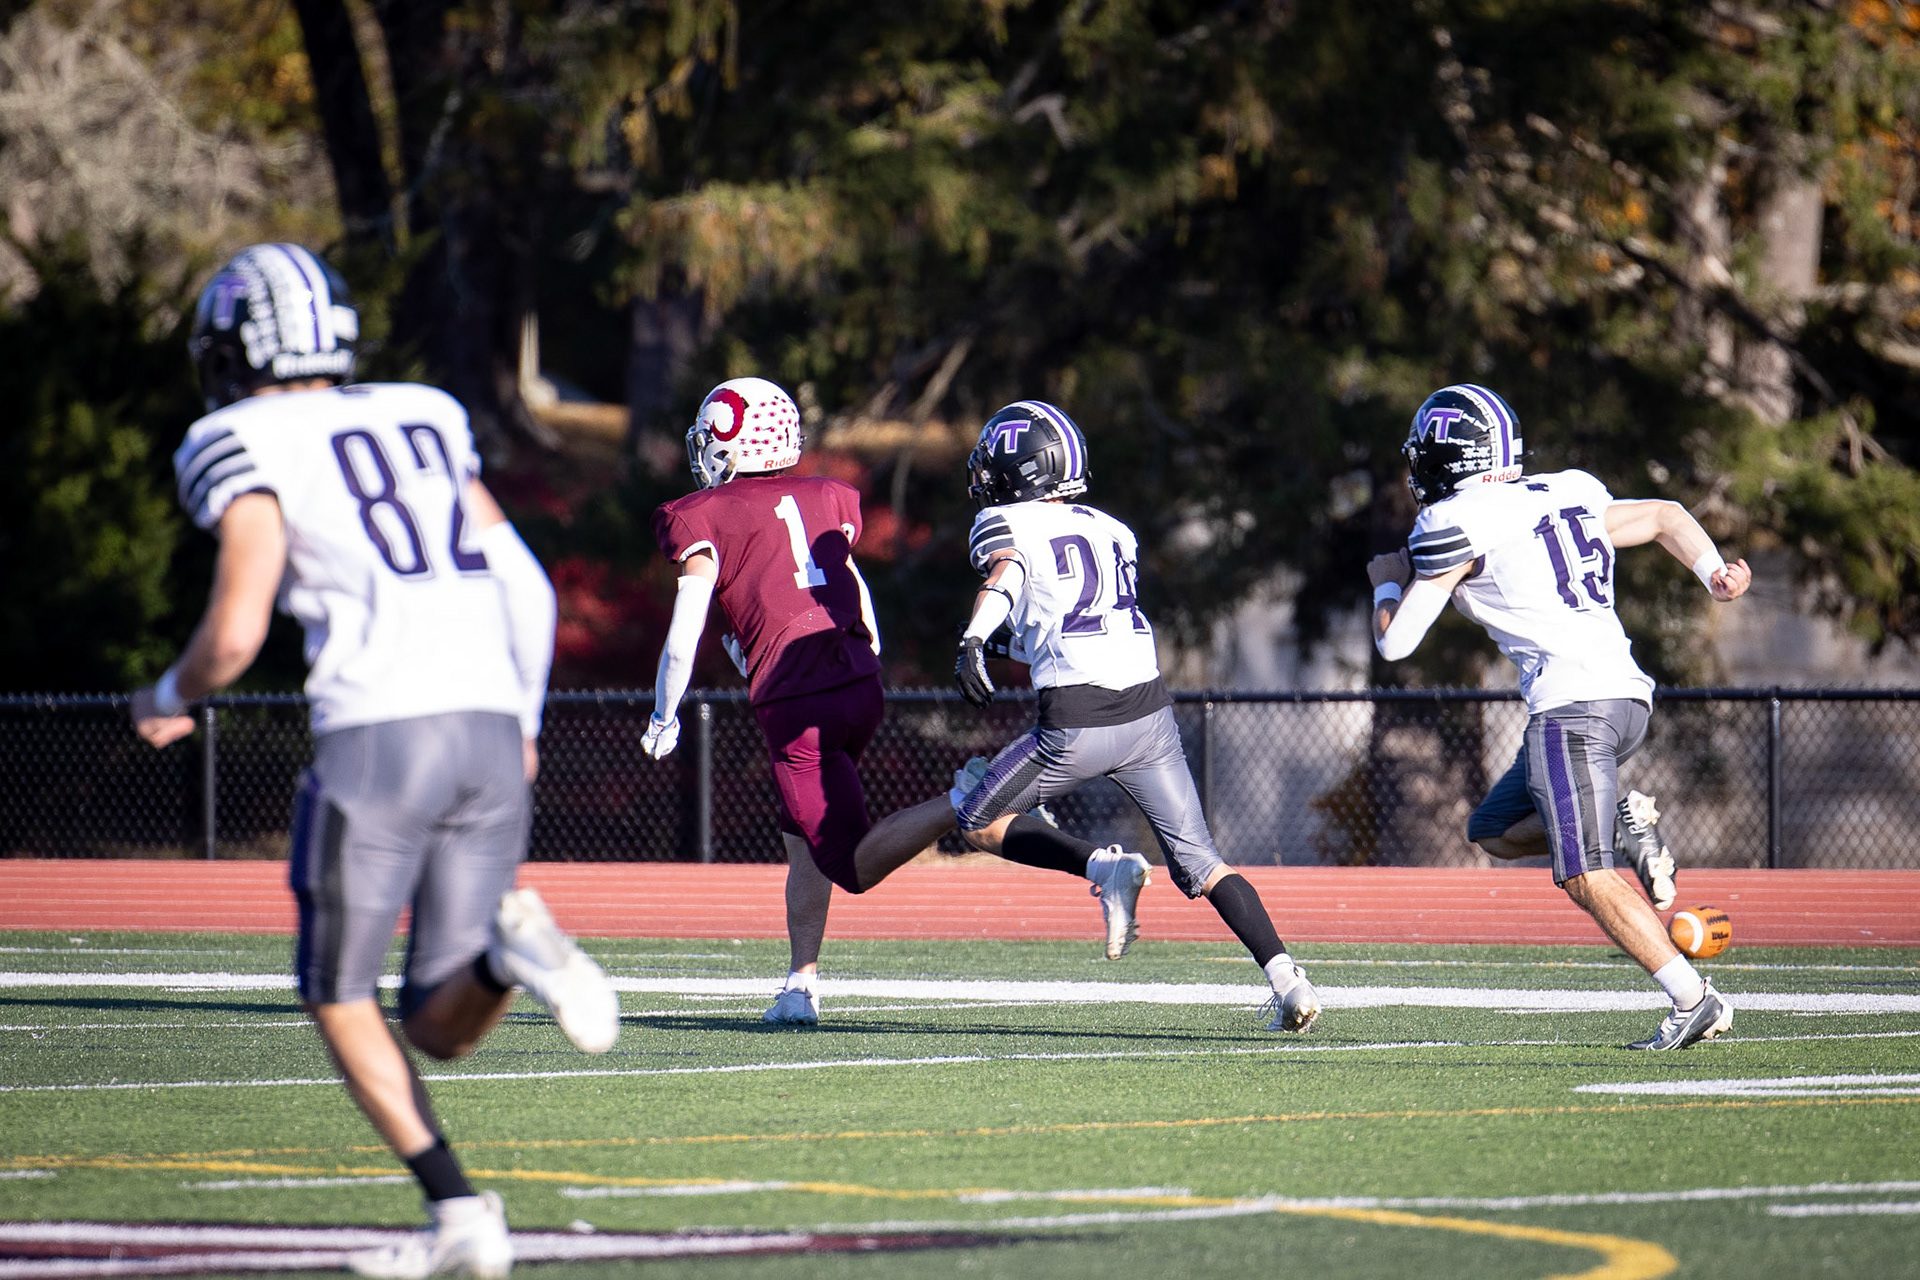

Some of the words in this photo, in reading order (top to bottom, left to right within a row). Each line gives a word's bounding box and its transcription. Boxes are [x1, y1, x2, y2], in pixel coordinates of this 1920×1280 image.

[330, 424, 490, 579] 82
[774, 494, 827, 589] 1
[1049, 534, 1150, 637] 24
[1533, 505, 1610, 610] 15
